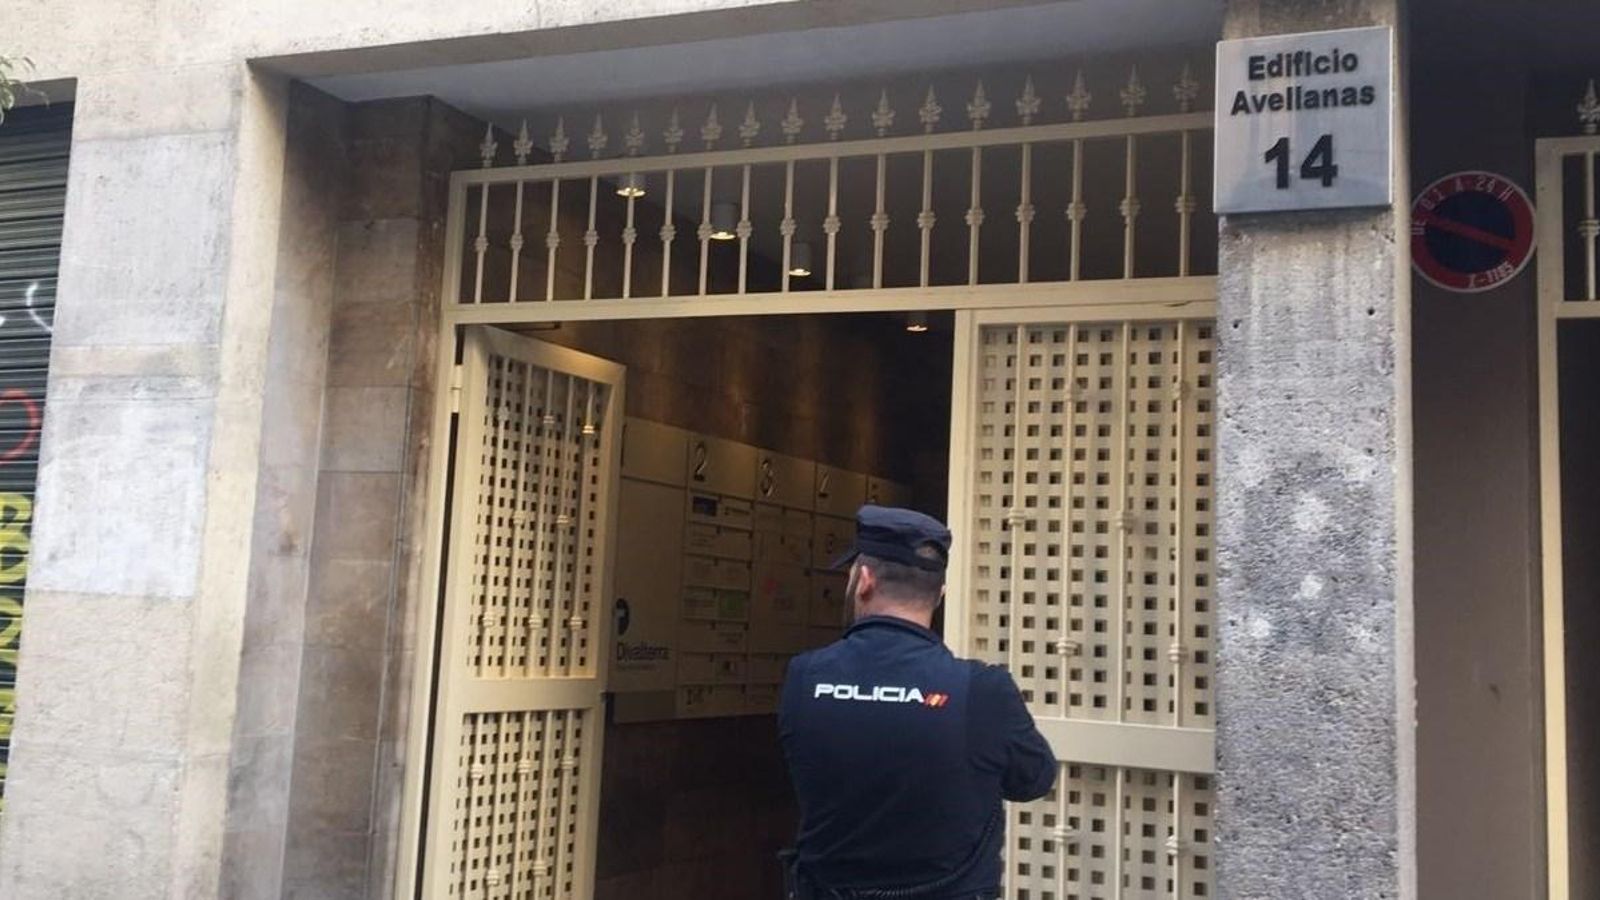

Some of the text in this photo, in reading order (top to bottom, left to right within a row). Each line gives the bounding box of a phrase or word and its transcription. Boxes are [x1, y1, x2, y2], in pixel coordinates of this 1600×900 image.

[1248, 48, 1359, 81] Edificio
[1230, 84, 1375, 115] Avellanas
[1264, 134, 1339, 190] 14
[1475, 175, 1497, 193] 24
[693, 440, 708, 482] 2
[759, 458, 775, 497] 3
[814, 683, 925, 703] POLICIA
